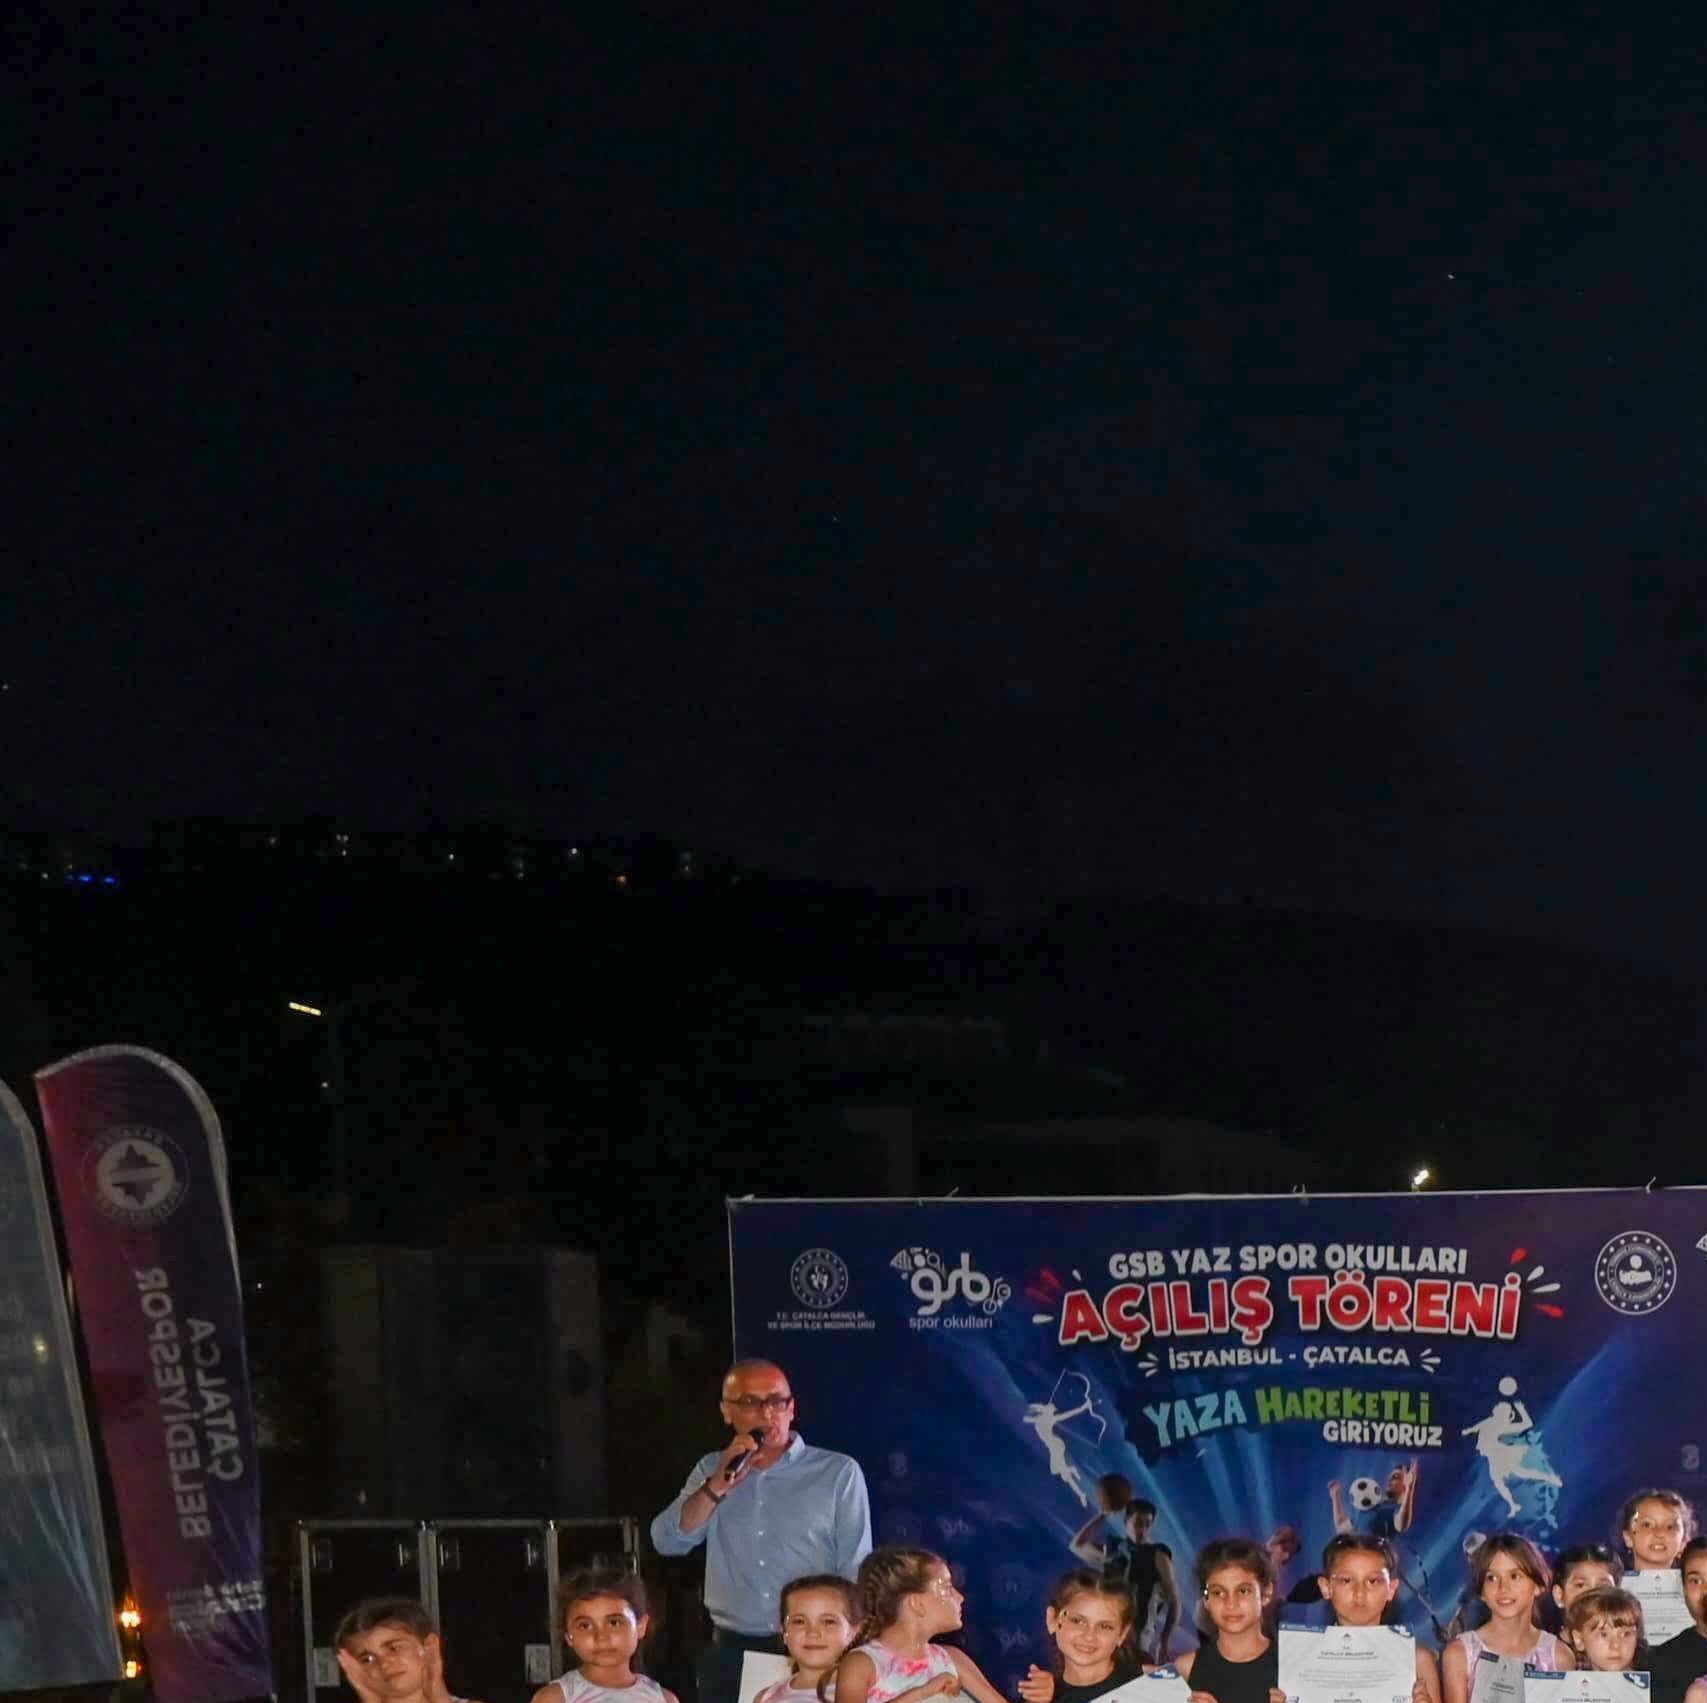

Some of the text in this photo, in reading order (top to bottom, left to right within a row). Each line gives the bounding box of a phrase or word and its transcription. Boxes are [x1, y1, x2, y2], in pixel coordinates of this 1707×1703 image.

[1109, 1243, 1468, 1279] GSB YAZ SPOR OKULLARI
[909, 1315, 993, 1331] spor okulları
[1058, 1273, 1275, 1352] AÇILIŞ
[1287, 1267, 1523, 1341] TÖRENİ
[1169, 1345, 1283, 1372] İSTANBUL
[1303, 1344, 1410, 1370] ÇATALCA
[1142, 1389, 1248, 1448] YAZA
